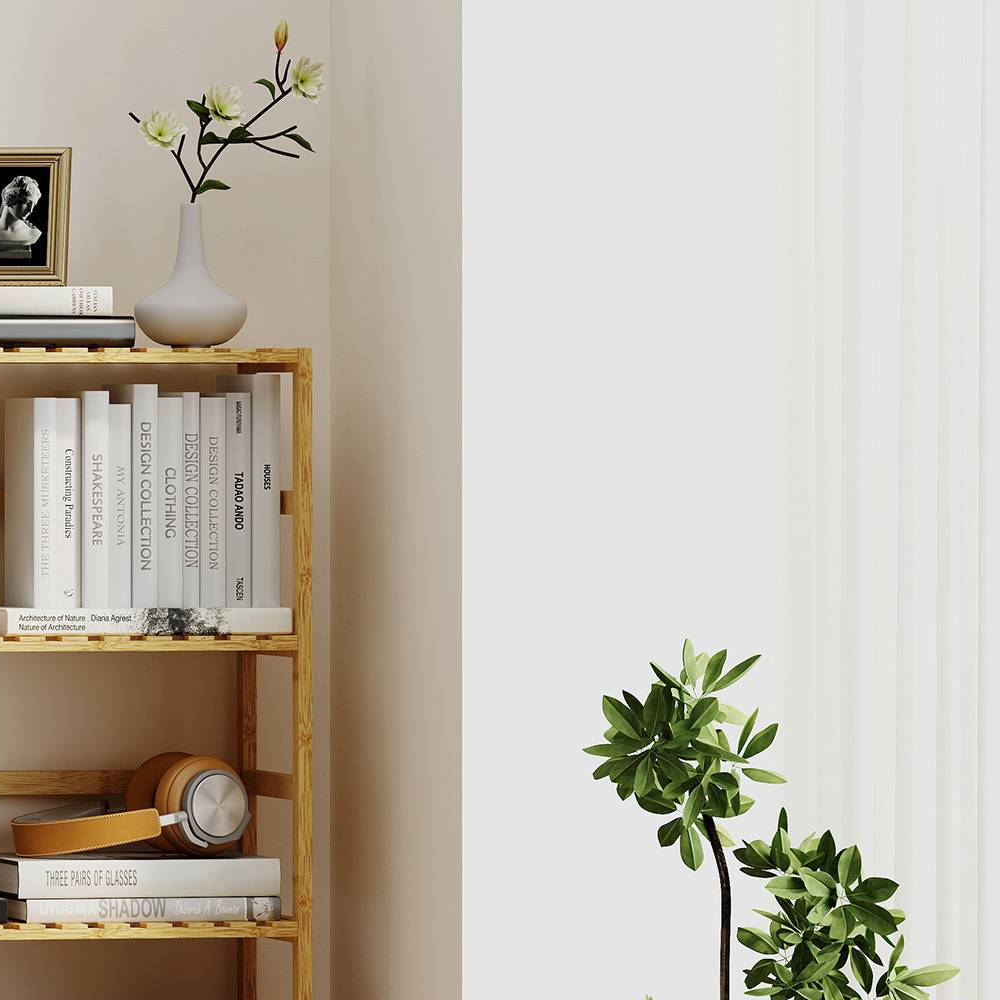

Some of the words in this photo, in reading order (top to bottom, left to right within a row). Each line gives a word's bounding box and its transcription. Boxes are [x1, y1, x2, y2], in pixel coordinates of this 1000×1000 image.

[41, 428, 50, 508] MUSKETEERS
[140, 421, 152, 475] DESIGN
[184, 433, 199, 483] DESIGN
[208, 436, 219, 485] DESIGN
[62, 448, 75, 502] Constructing
[116, 465, 126, 481] MY
[234, 471, 244, 503] TADAO
[263, 464, 272, 490] HOUSES
[91, 453, 103, 546] SHAKESPEARE
[116, 488, 126, 546] ANTONIA
[164, 467, 177, 539] CLOTHING
[234, 504, 244, 531] ANDO
[41, 511, 50, 552] THREE
[140, 479, 152, 571] COLLECTION
[184, 487, 199, 569] COLLECTION
[208, 489, 219, 571] COLLECTION
[41, 554, 50, 578] THE
[18, 614, 56, 622] Architecture
[57, 614, 64, 622] of
[64, 614, 86, 622] Nature
[90, 614, 110, 622] Diana
[110, 614, 132, 624] Agrest
[40, 623, 48, 631] of
[47, 623, 86, 631] Architecture
[45, 870, 69, 887] THREE
[70, 870, 92, 887] PAIRS
[93, 870, 104, 887] OF
[105, 869, 138, 887] GLASSES
[98, 898, 166, 919] SHADOW
